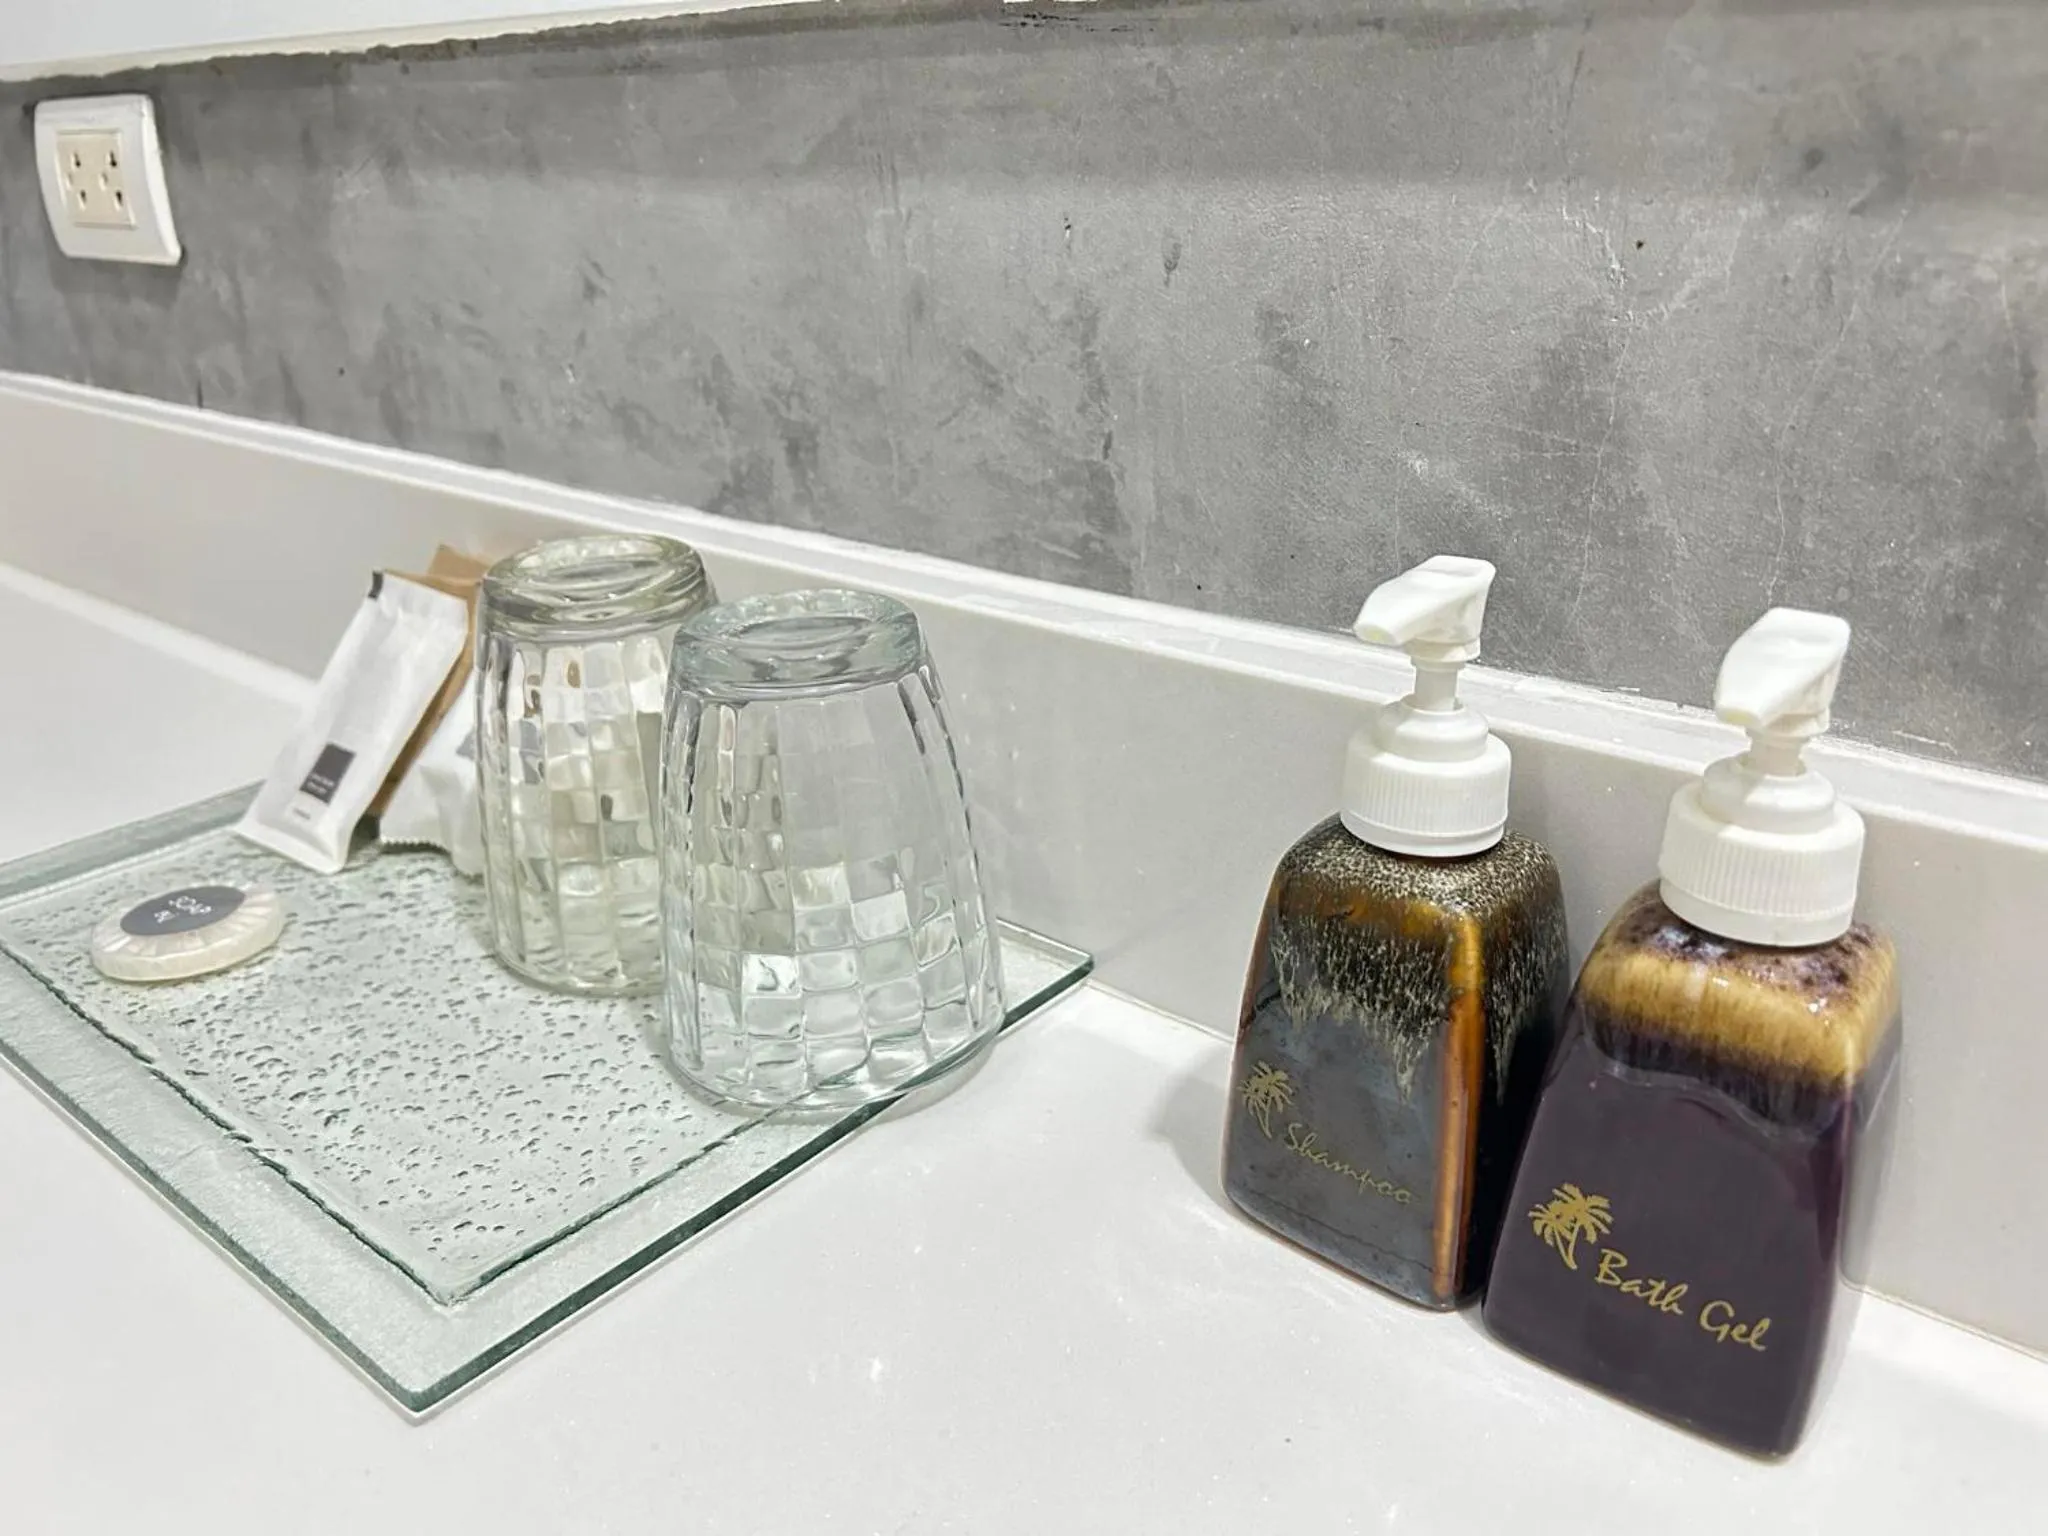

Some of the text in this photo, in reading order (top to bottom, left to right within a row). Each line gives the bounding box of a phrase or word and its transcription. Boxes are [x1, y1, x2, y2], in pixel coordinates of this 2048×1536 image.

[1286, 1122, 1411, 1204] Shampoo
[1595, 1248, 1771, 1351] Bath Gel
